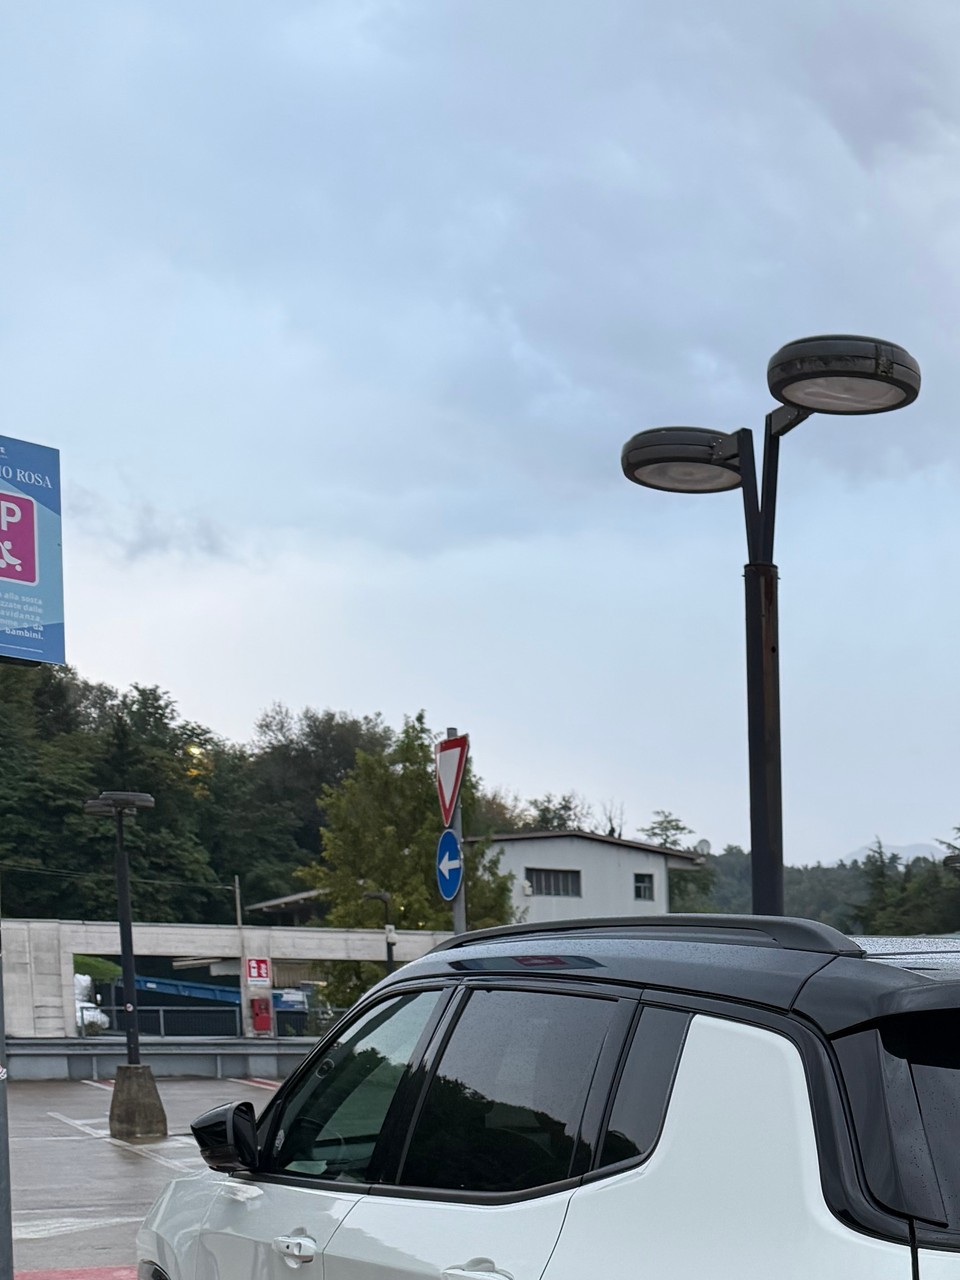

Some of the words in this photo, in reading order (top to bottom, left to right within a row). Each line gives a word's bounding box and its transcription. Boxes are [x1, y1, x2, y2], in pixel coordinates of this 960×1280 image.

[17, 468, 53, 489] ROSA
[1, 500, 22, 531] P
[6, 627, 44, 640] bambini.
[33, 623, 44, 632] da
